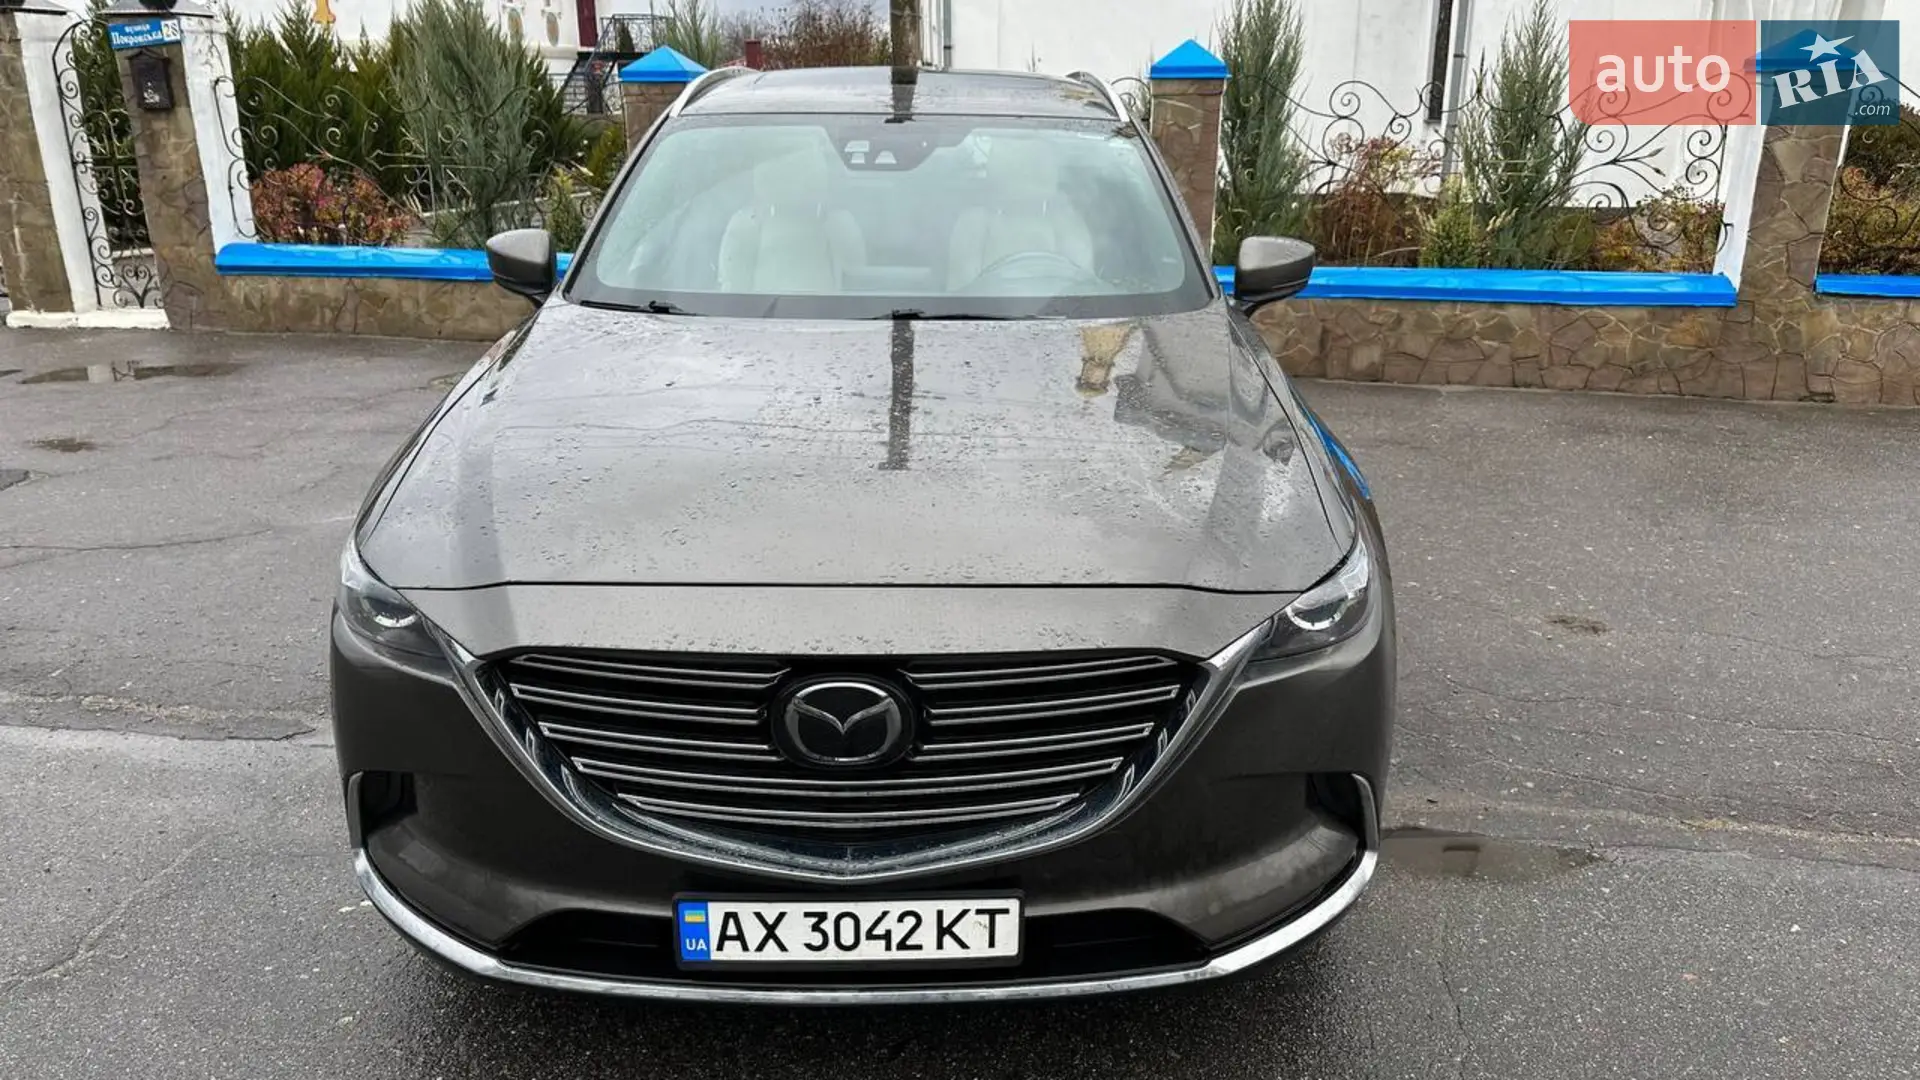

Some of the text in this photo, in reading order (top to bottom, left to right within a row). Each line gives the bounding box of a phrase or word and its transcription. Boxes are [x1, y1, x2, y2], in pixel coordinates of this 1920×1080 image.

[715, 908, 1010, 952] AX 3042 KT
[686, 938, 708, 951] UA
